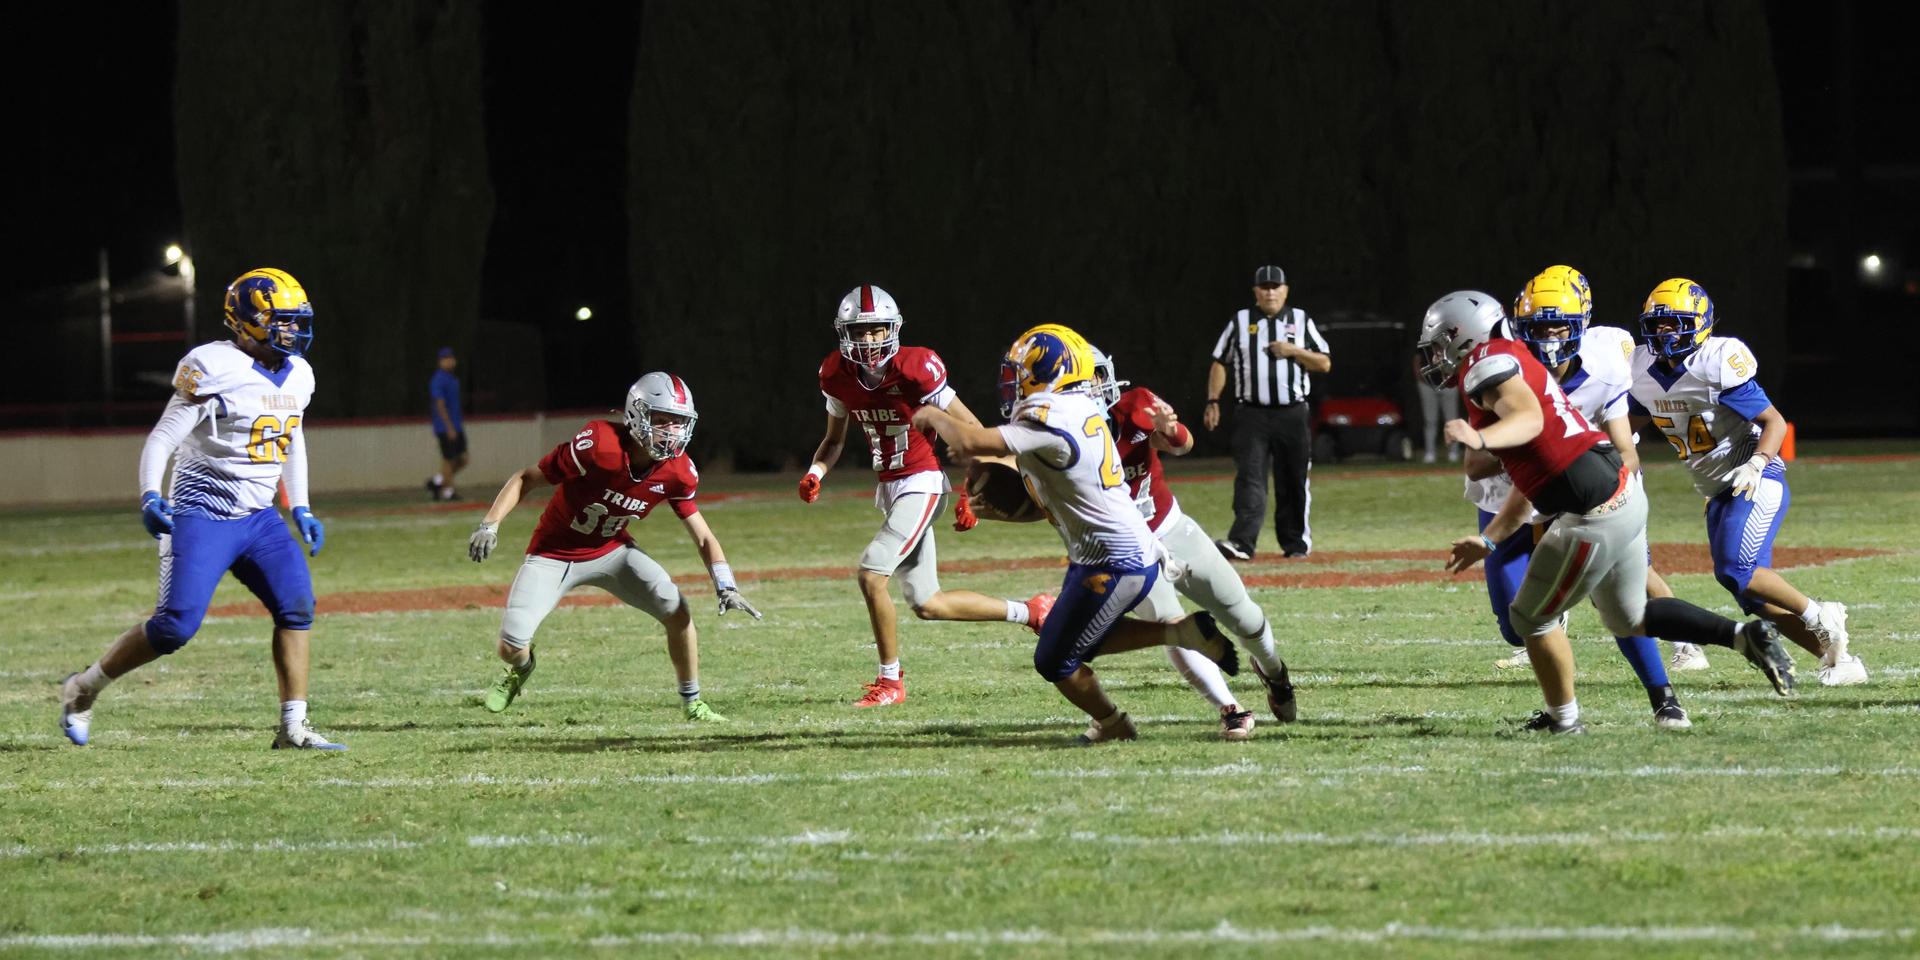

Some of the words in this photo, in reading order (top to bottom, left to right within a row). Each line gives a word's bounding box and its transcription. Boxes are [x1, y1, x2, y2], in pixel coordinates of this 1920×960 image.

[1727, 345, 1756, 377] 54
[175, 365, 204, 394] 66
[852, 409, 901, 422] TRIBE
[1651, 415, 1718, 461] 54
[602, 488, 649, 513] TRIBE
